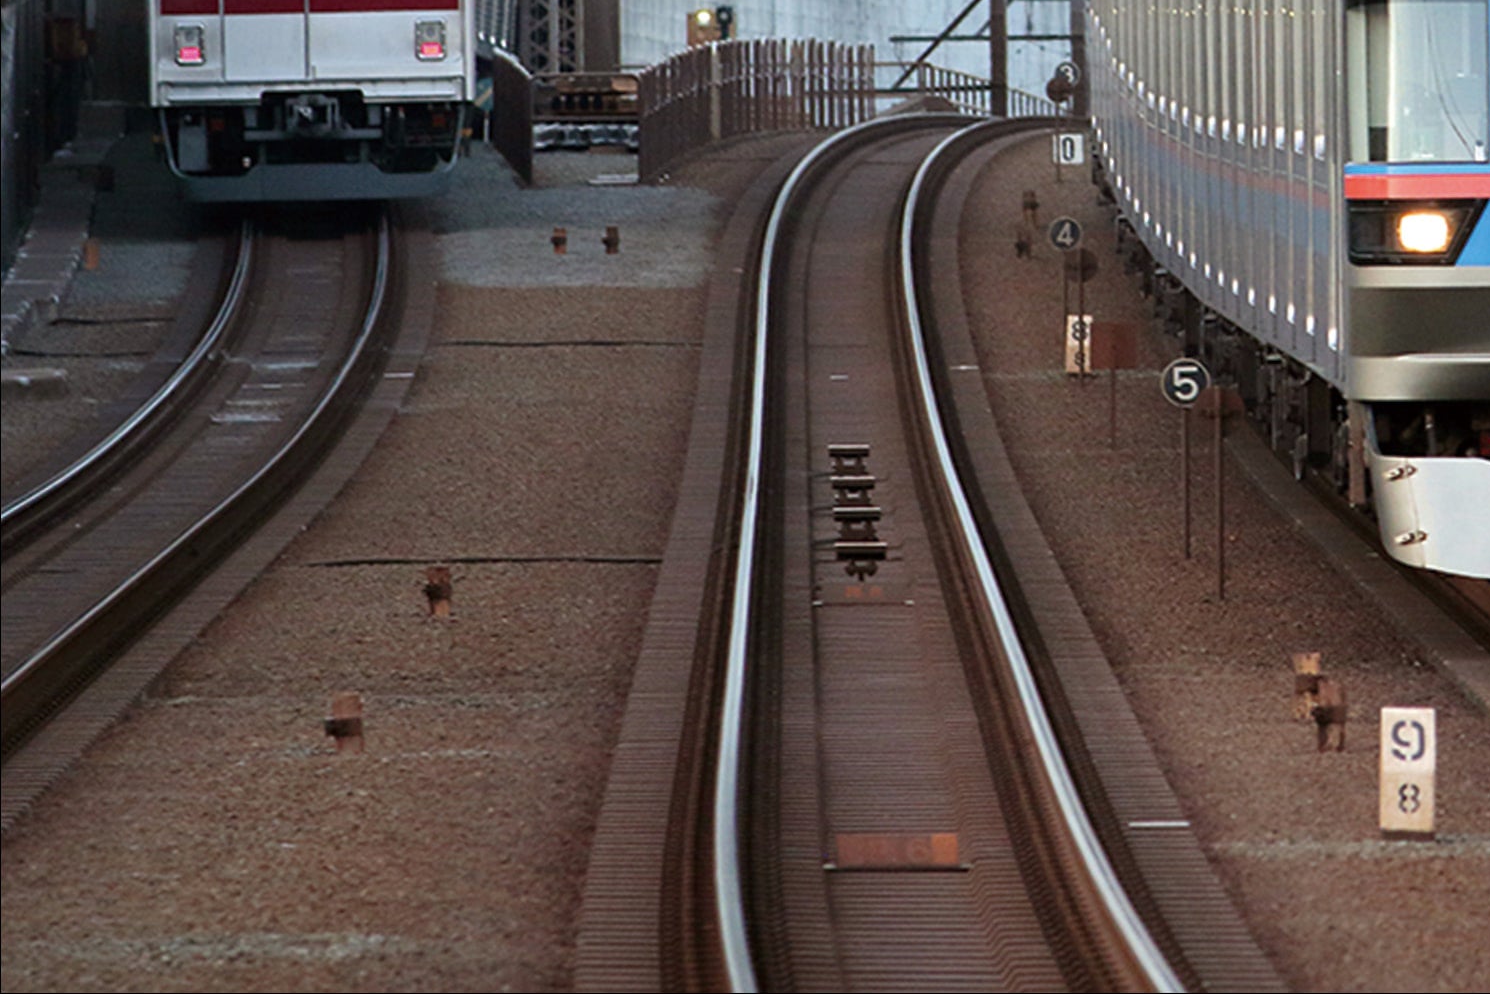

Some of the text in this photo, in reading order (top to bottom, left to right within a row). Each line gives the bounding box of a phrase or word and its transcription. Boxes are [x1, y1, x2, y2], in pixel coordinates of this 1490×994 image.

[1056, 221, 1074, 247] 4
[1172, 365, 1200, 402] 5
[1391, 719, 1426, 762] 9
[1398, 782, 1421, 814] 8
